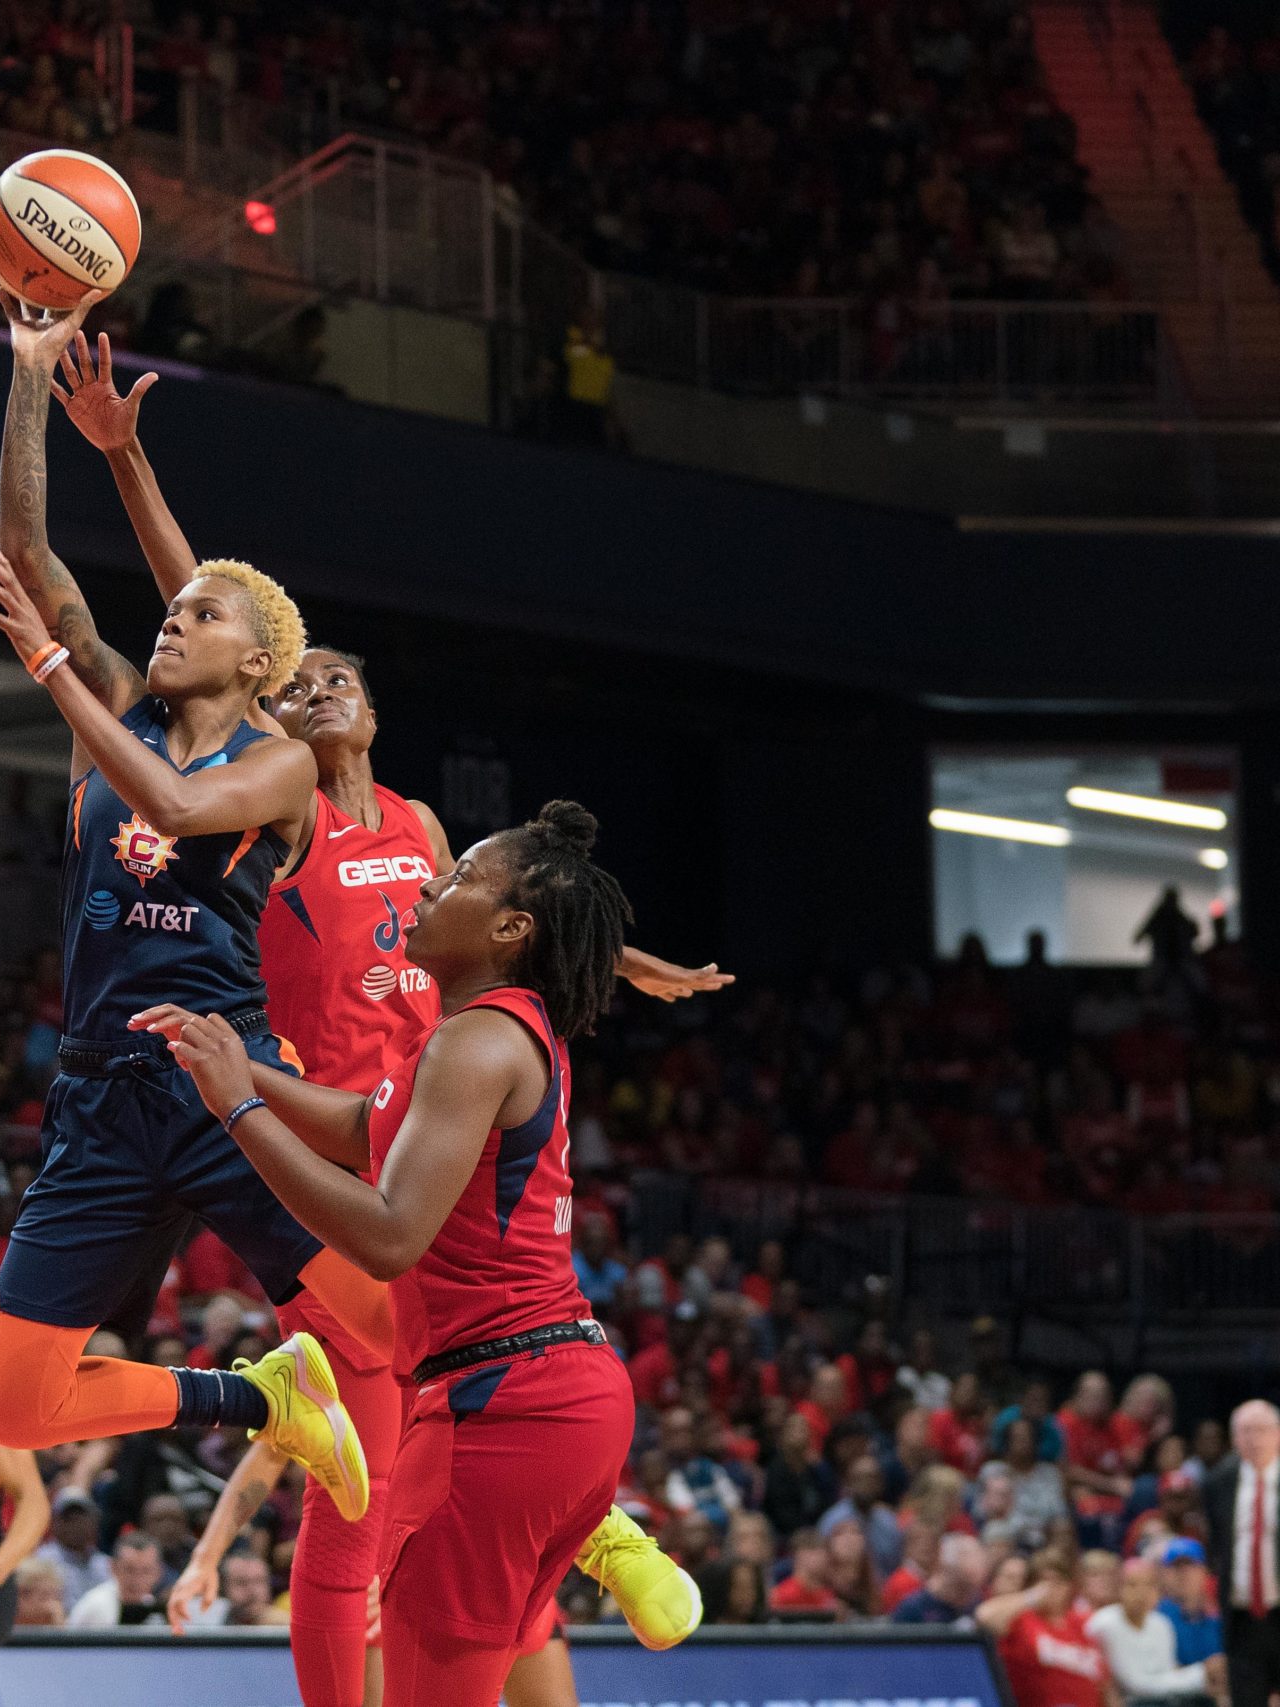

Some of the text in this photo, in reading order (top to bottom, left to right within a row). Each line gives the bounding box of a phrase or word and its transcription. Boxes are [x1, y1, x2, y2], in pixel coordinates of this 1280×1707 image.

[16, 197, 113, 282] SPALDING
[128, 861, 152, 875] SUN
[338, 855, 433, 887] GEICO
[124, 901, 199, 932] AT&T
